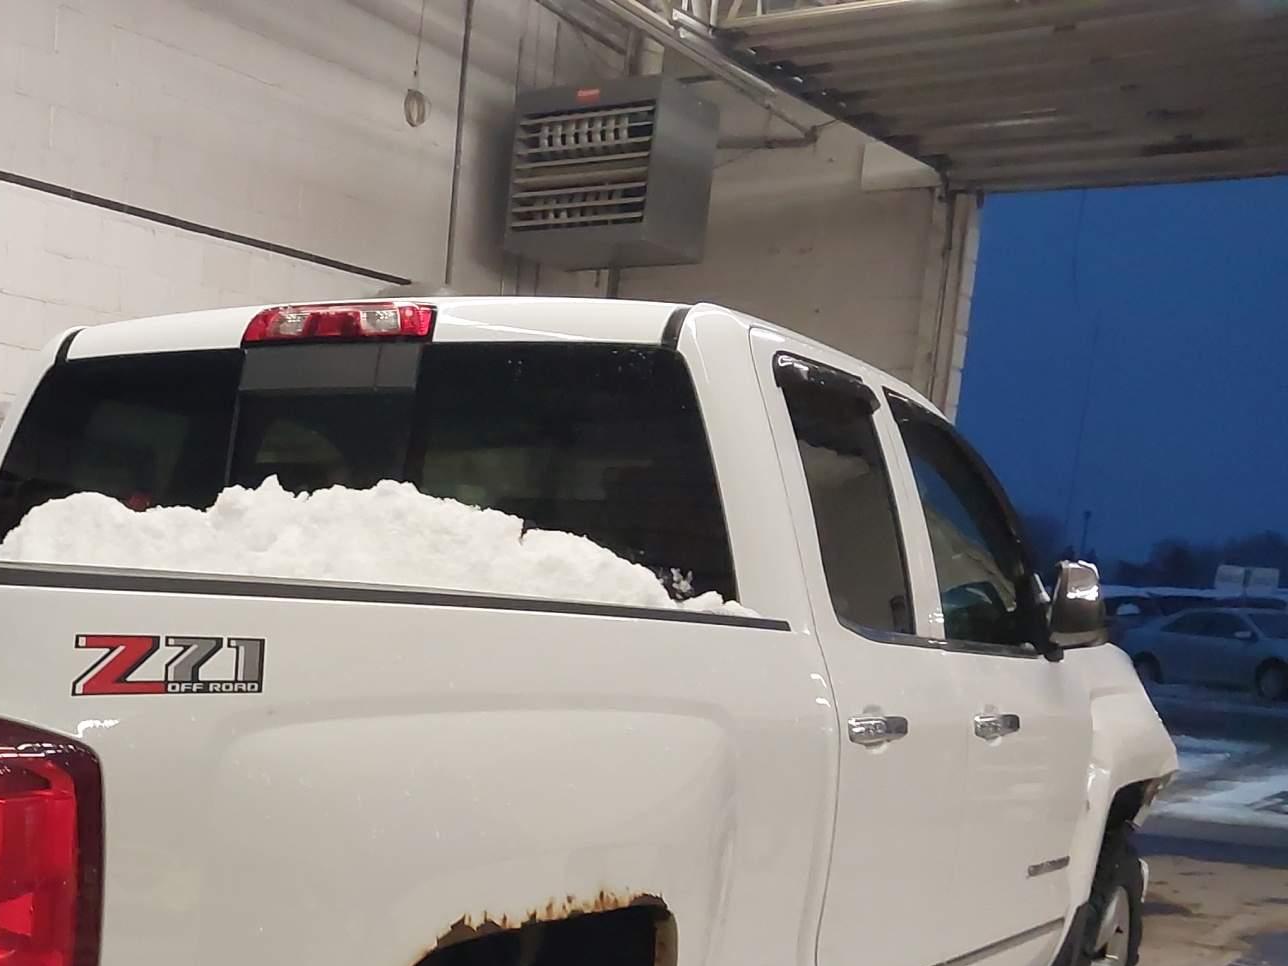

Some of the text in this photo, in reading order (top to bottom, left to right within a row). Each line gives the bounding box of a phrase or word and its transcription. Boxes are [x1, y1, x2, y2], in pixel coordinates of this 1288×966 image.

[72, 634, 265, 696] Z71
[167, 682, 259, 692] OFF ROAD
